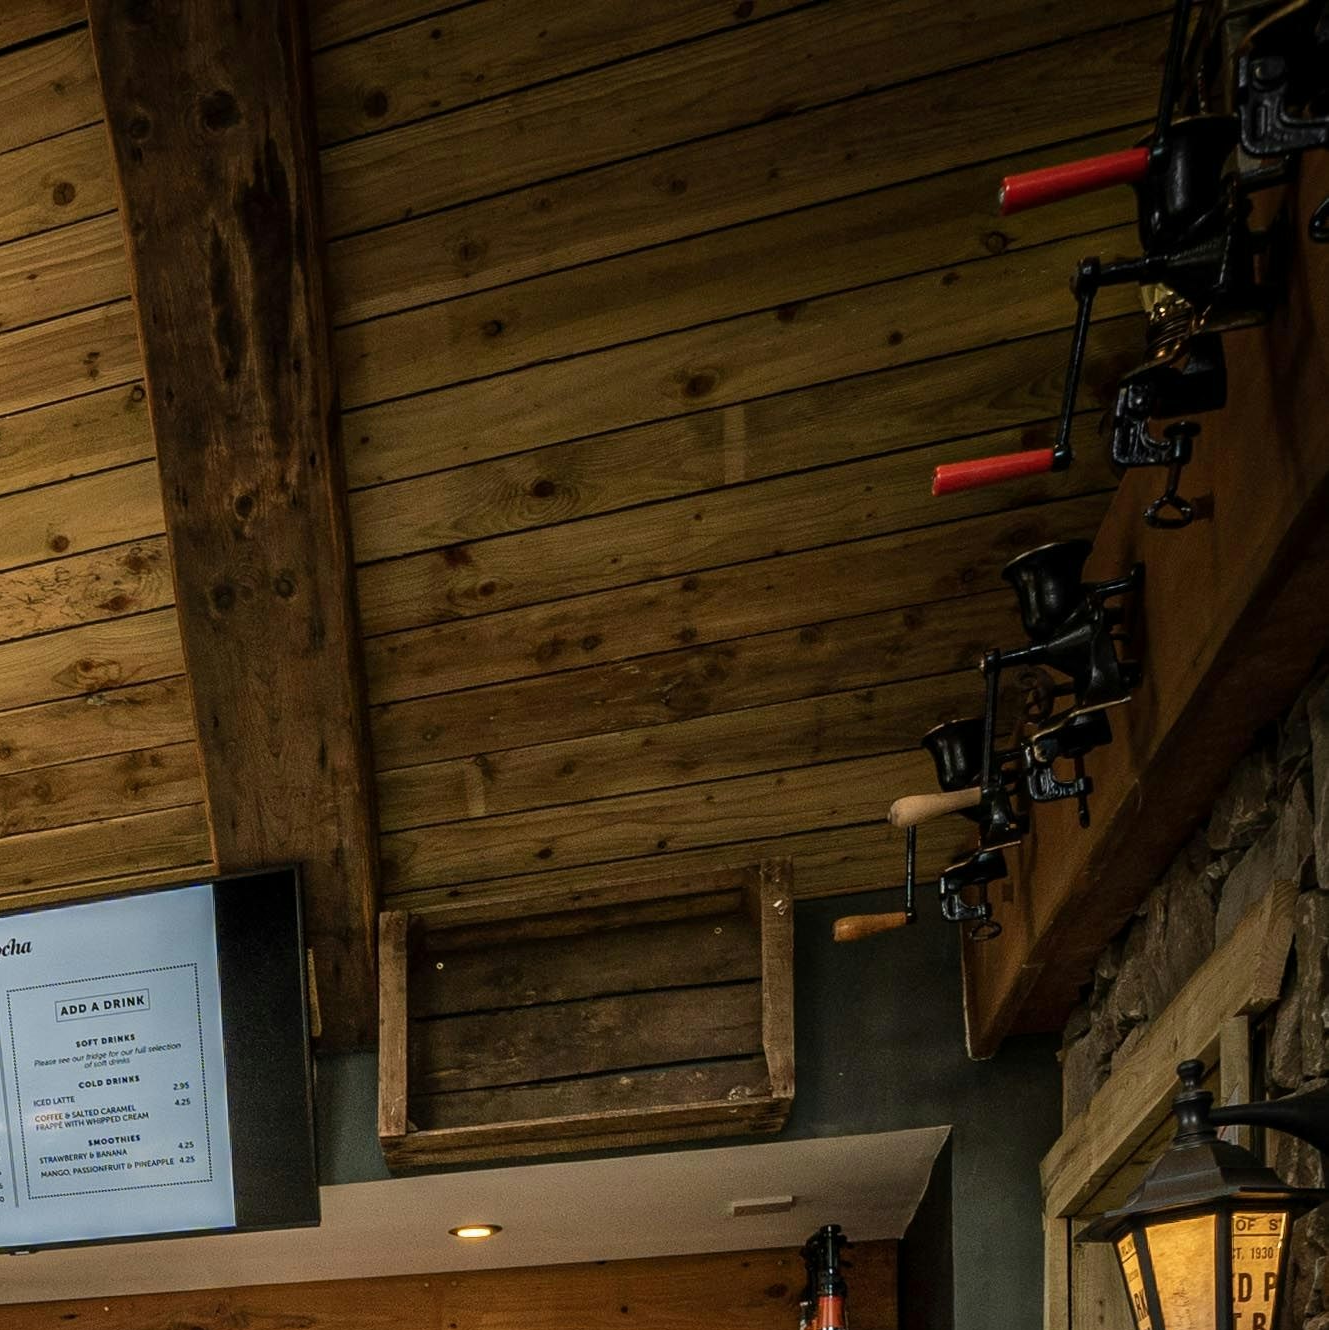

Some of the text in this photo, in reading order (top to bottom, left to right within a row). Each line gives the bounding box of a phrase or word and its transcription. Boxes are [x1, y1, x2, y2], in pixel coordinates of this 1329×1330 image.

[60, 995, 144, 1016] ADD A DRINK
[75, 1033, 135, 1048] SOFT DRINKS
[78, 1074, 140, 1088] COLD DRINKS
[33, 1081, 189, 1107] ICED LATTE 2.95
[34, 1112, 63, 1122] COFFEE
[71, 1108, 99, 1118] SALTED
[100, 1104, 136, 1115] CARAMEL
[174, 1097, 190, 1106] 4.25
[64, 1112, 149, 1128] WITH WHIPPED CREAM
[87, 1134, 140, 1146] SMOOTHIES
[39, 1152, 87, 1164] STRAWBERRY
[95, 1148, 127, 1158] BANANA
[177, 1141, 193, 1149] 4.25
[1236, 1221, 1256, 1231] OF
[1251, 1248, 1274, 1259] 1930
